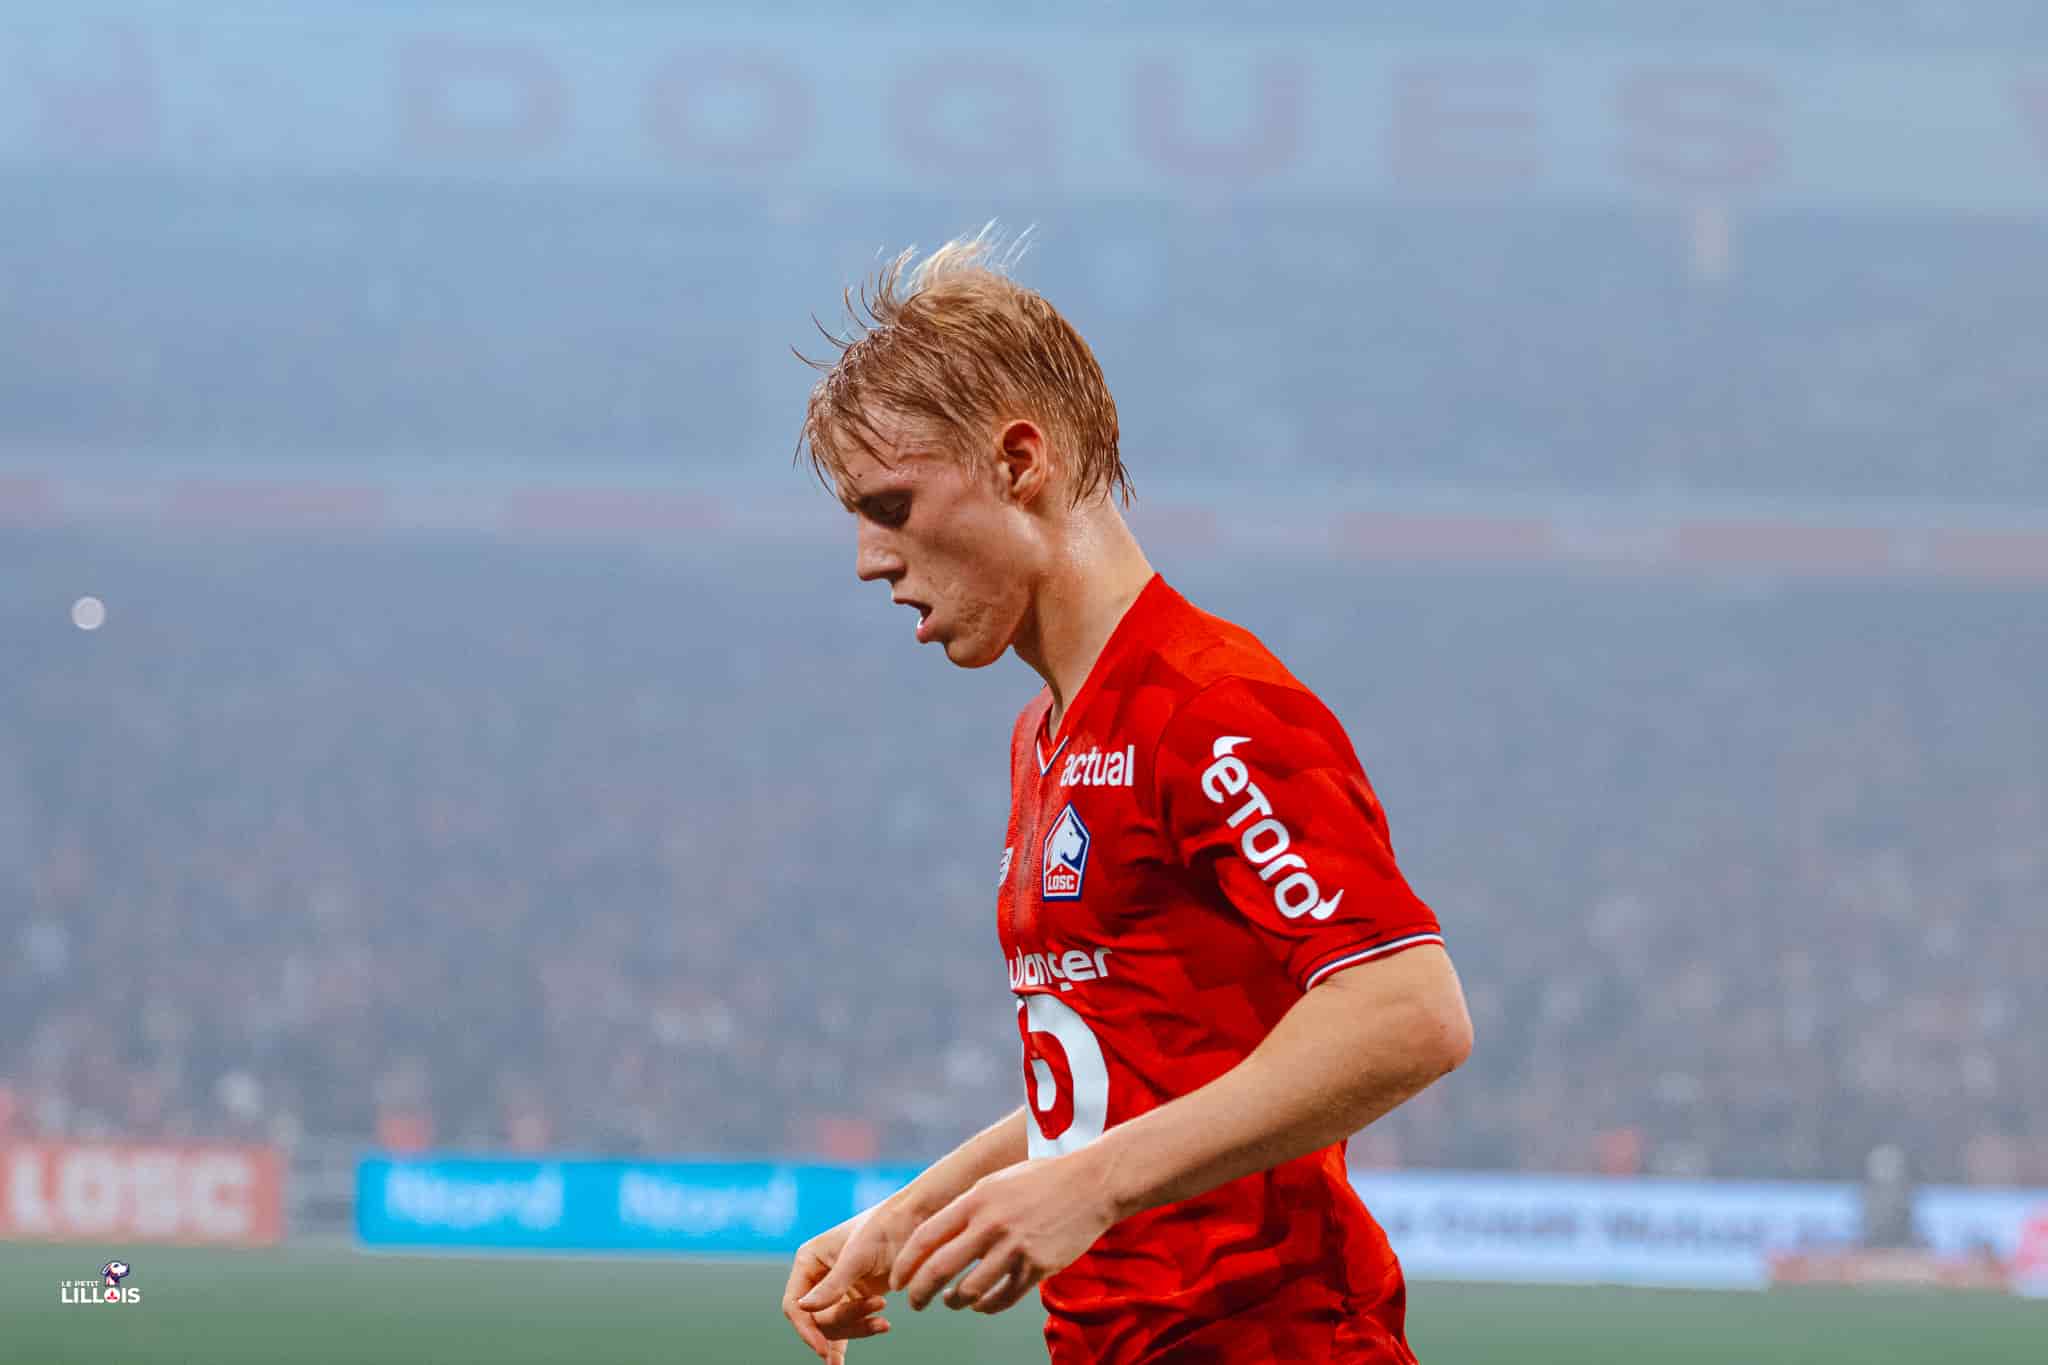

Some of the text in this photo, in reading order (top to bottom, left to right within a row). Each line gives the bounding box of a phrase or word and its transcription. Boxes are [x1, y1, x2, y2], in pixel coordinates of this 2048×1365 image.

[1060, 744, 1135, 787] actual
[1047, 874, 1076, 891] LOSC
[8, 1148, 253, 1234] LOSC
